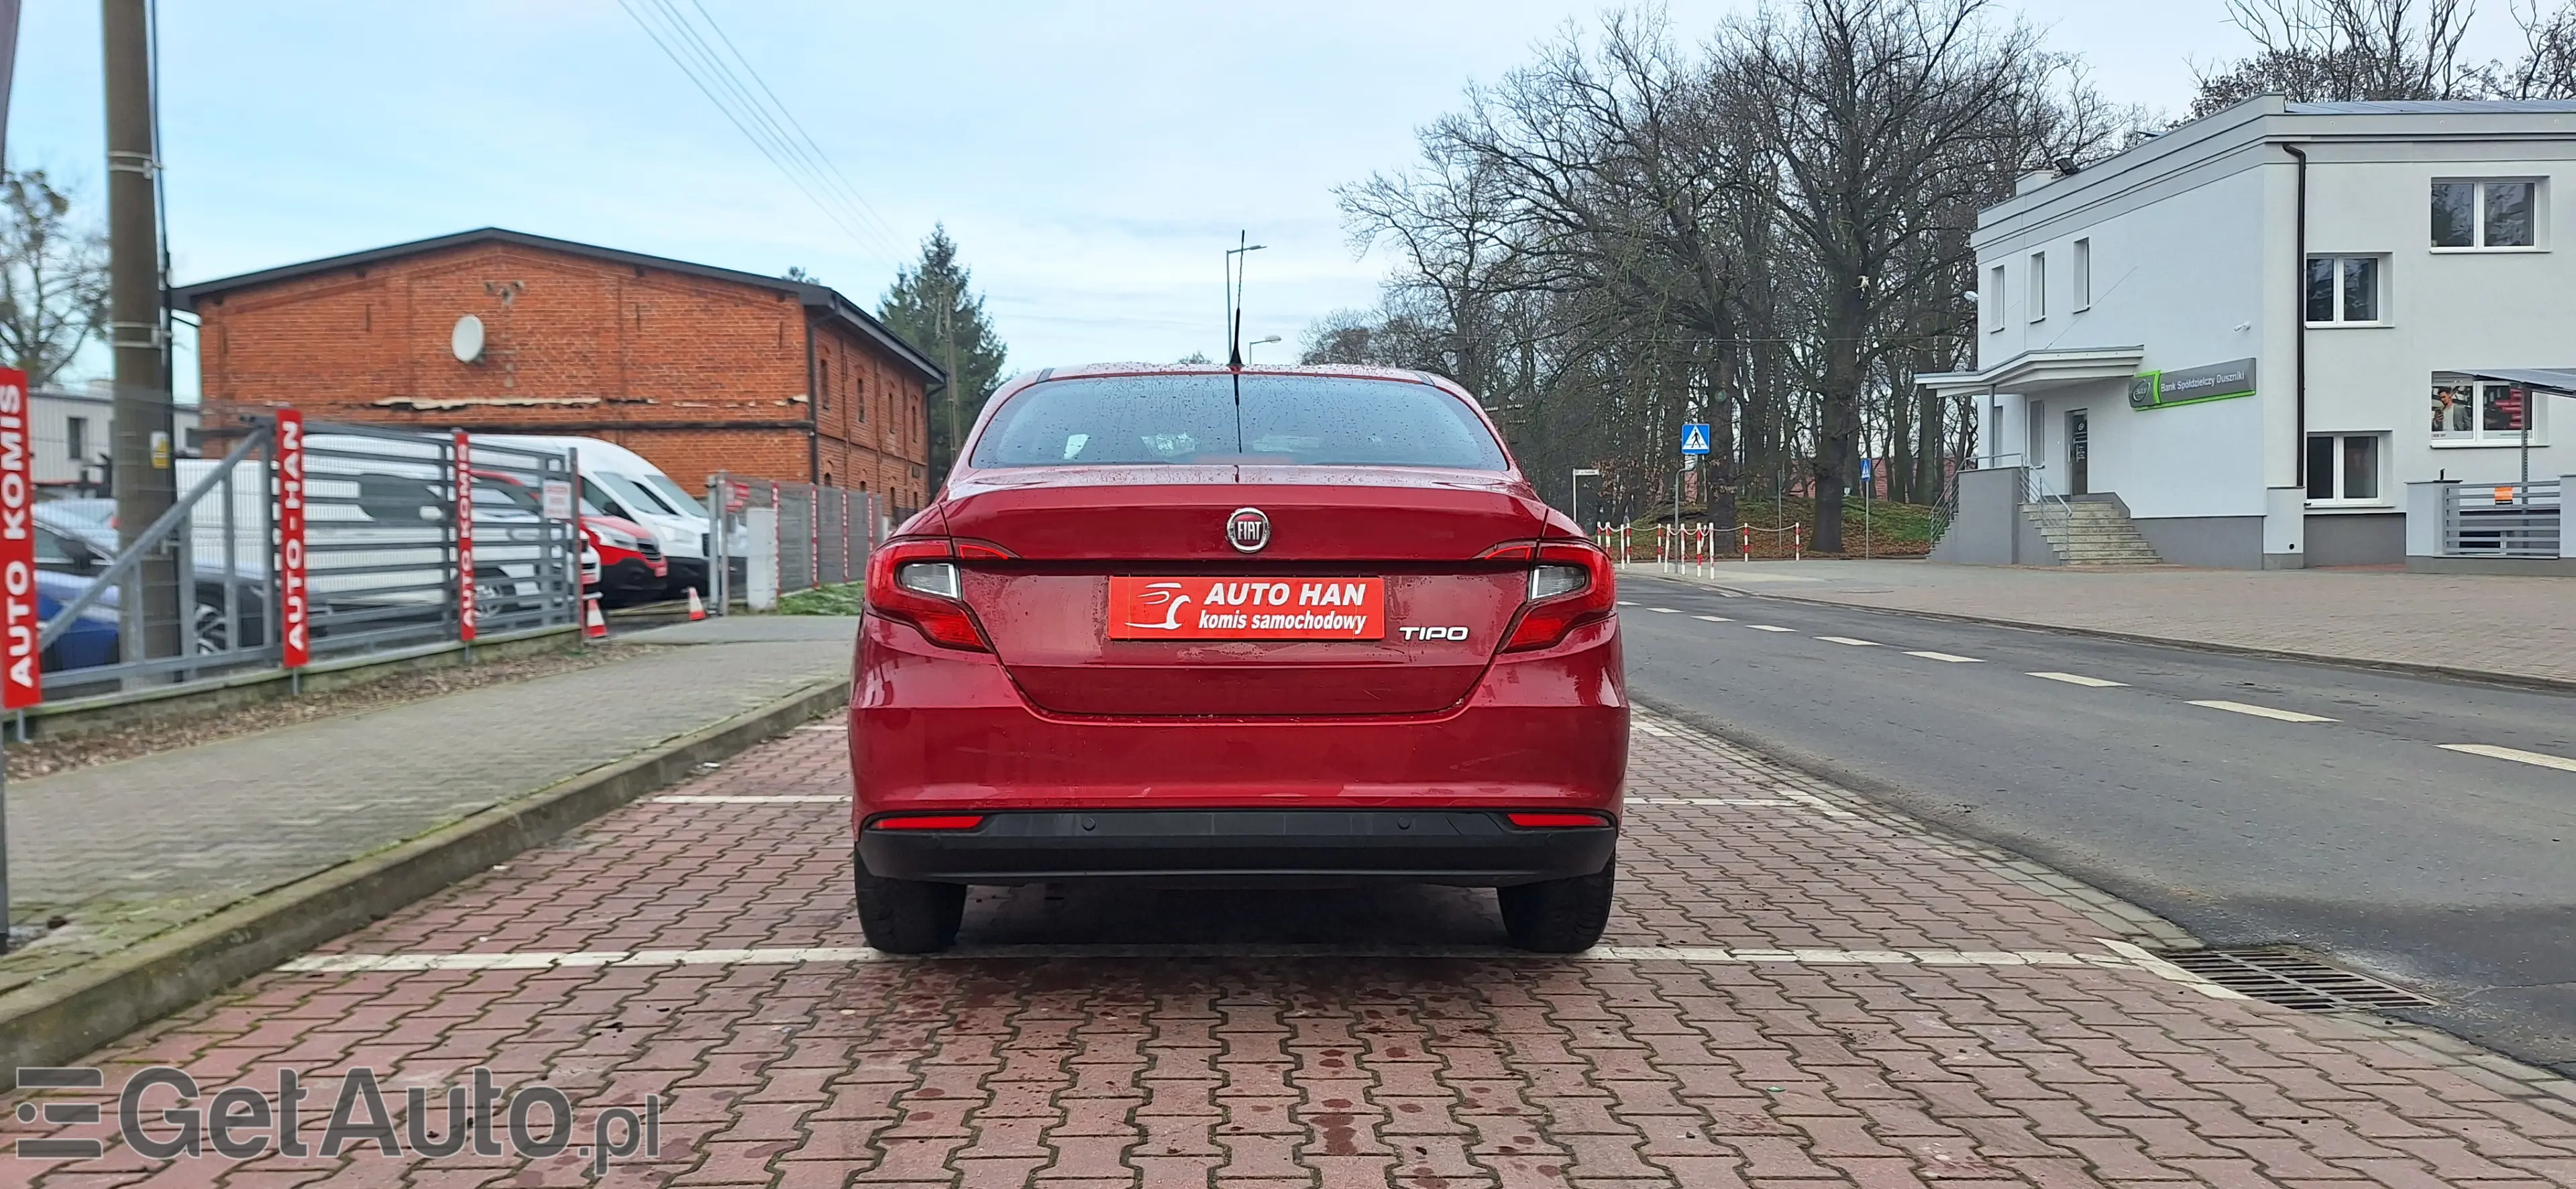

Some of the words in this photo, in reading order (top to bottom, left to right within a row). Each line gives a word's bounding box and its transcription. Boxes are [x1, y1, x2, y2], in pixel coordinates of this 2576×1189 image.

[2161, 382, 2176, 392] Bank
[2216, 370, 2245, 384] Duszniki
[0, 383, 26, 540] KOMIS
[1237, 520, 1263, 541] FIAT
[1203, 582, 1291, 606] AUTO
[1297, 583, 1366, 606] HAN
[5, 560, 34, 689] AUTO
[1197, 609, 1248, 629] komis
[1250, 610, 1367, 635] samochodowy
[1398, 626, 1469, 641] TIPO
